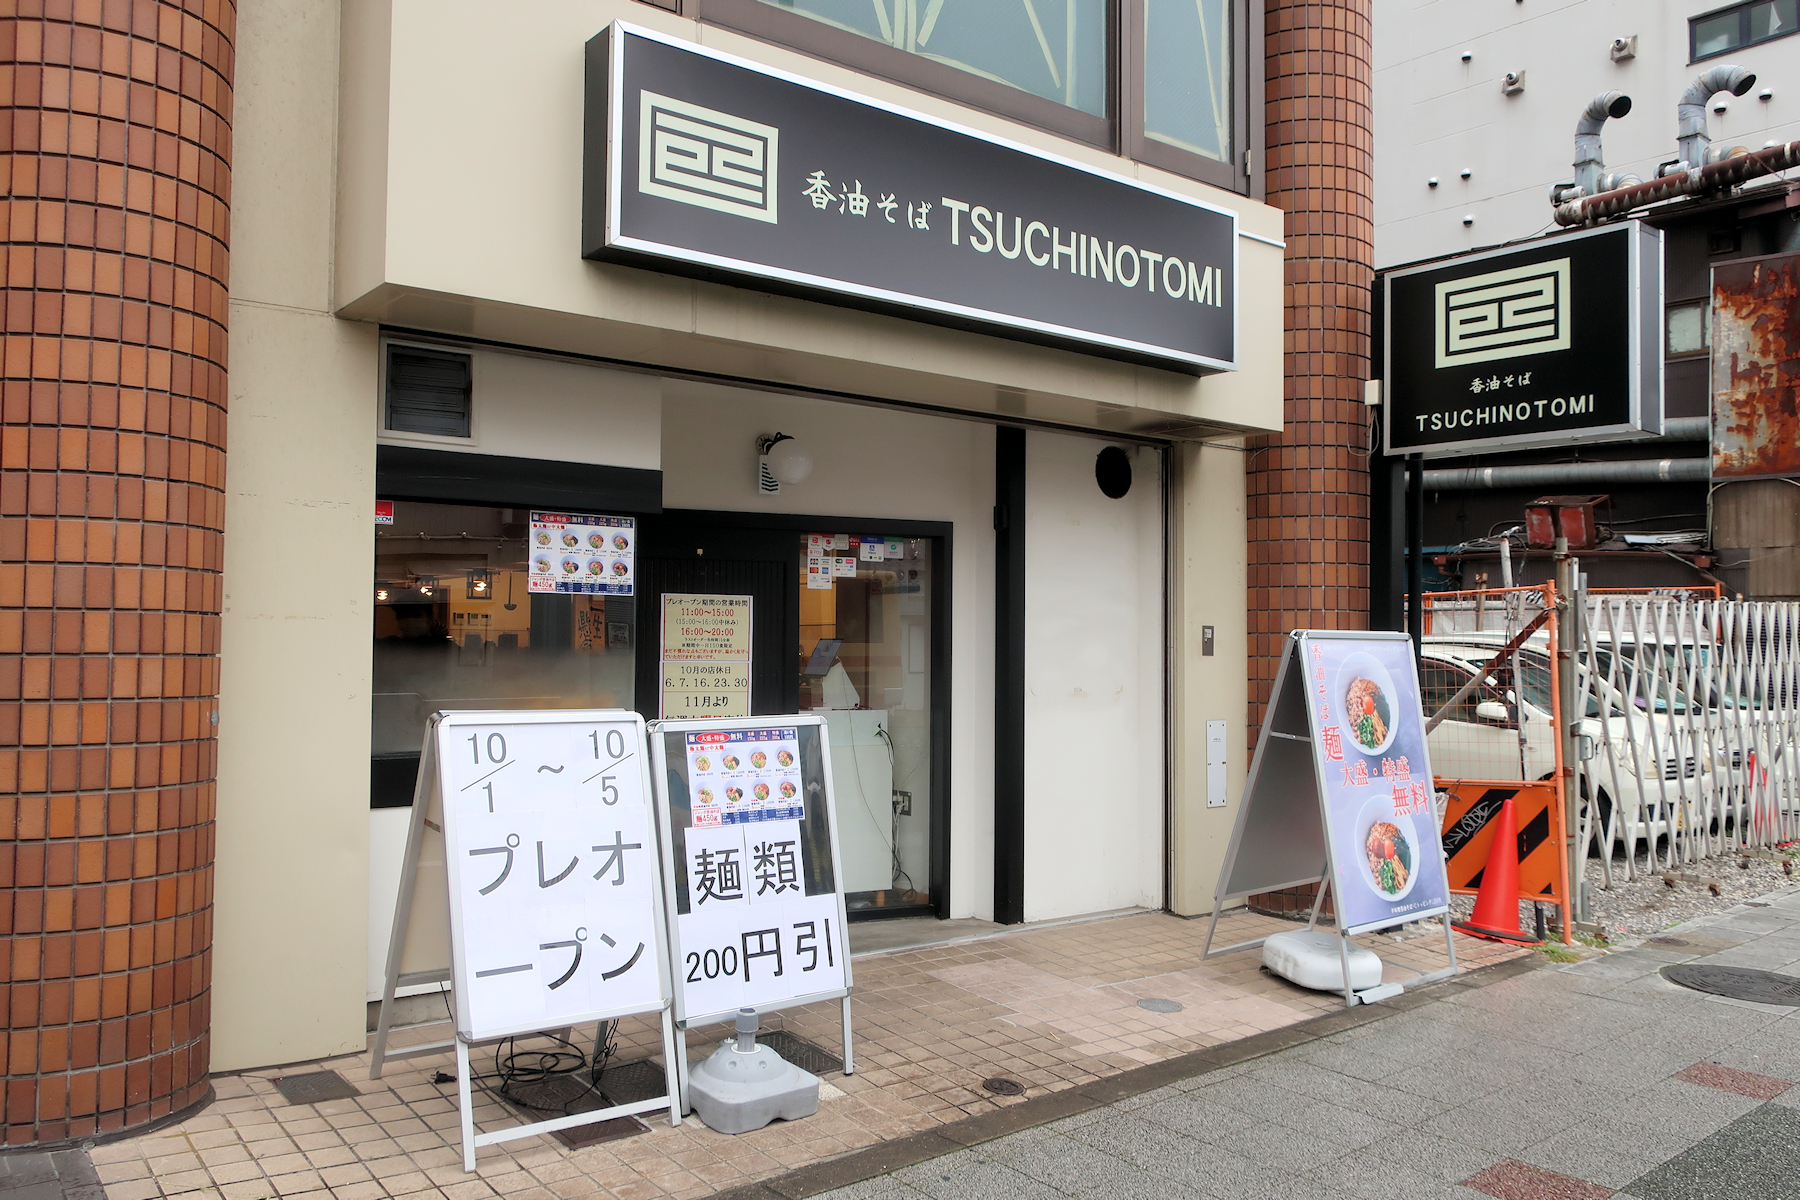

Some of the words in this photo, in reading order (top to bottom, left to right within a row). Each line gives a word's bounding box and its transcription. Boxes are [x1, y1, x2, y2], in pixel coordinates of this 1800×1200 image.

[801, 169, 932, 231] 香油そば
[941, 195, 1223, 308] TSUCHINOTOMI
[1469, 371, 1532, 395] 香油そば
[1416, 393, 1595, 432] TSUCHINOTOMI
[680, 666, 731, 675] 10月の店休日
[1311, 644, 1330, 720] 香油そば
[684, 696, 729, 708] 11月より
[1340, 755, 1411, 789] 大盛・特盛
[1391, 779, 1430, 817] 無料
[468, 830, 642, 896] プレオ
[693, 840, 801, 906] 麺類
[475, 926, 646, 991] ープン
[686, 918, 835, 983] 200円引
